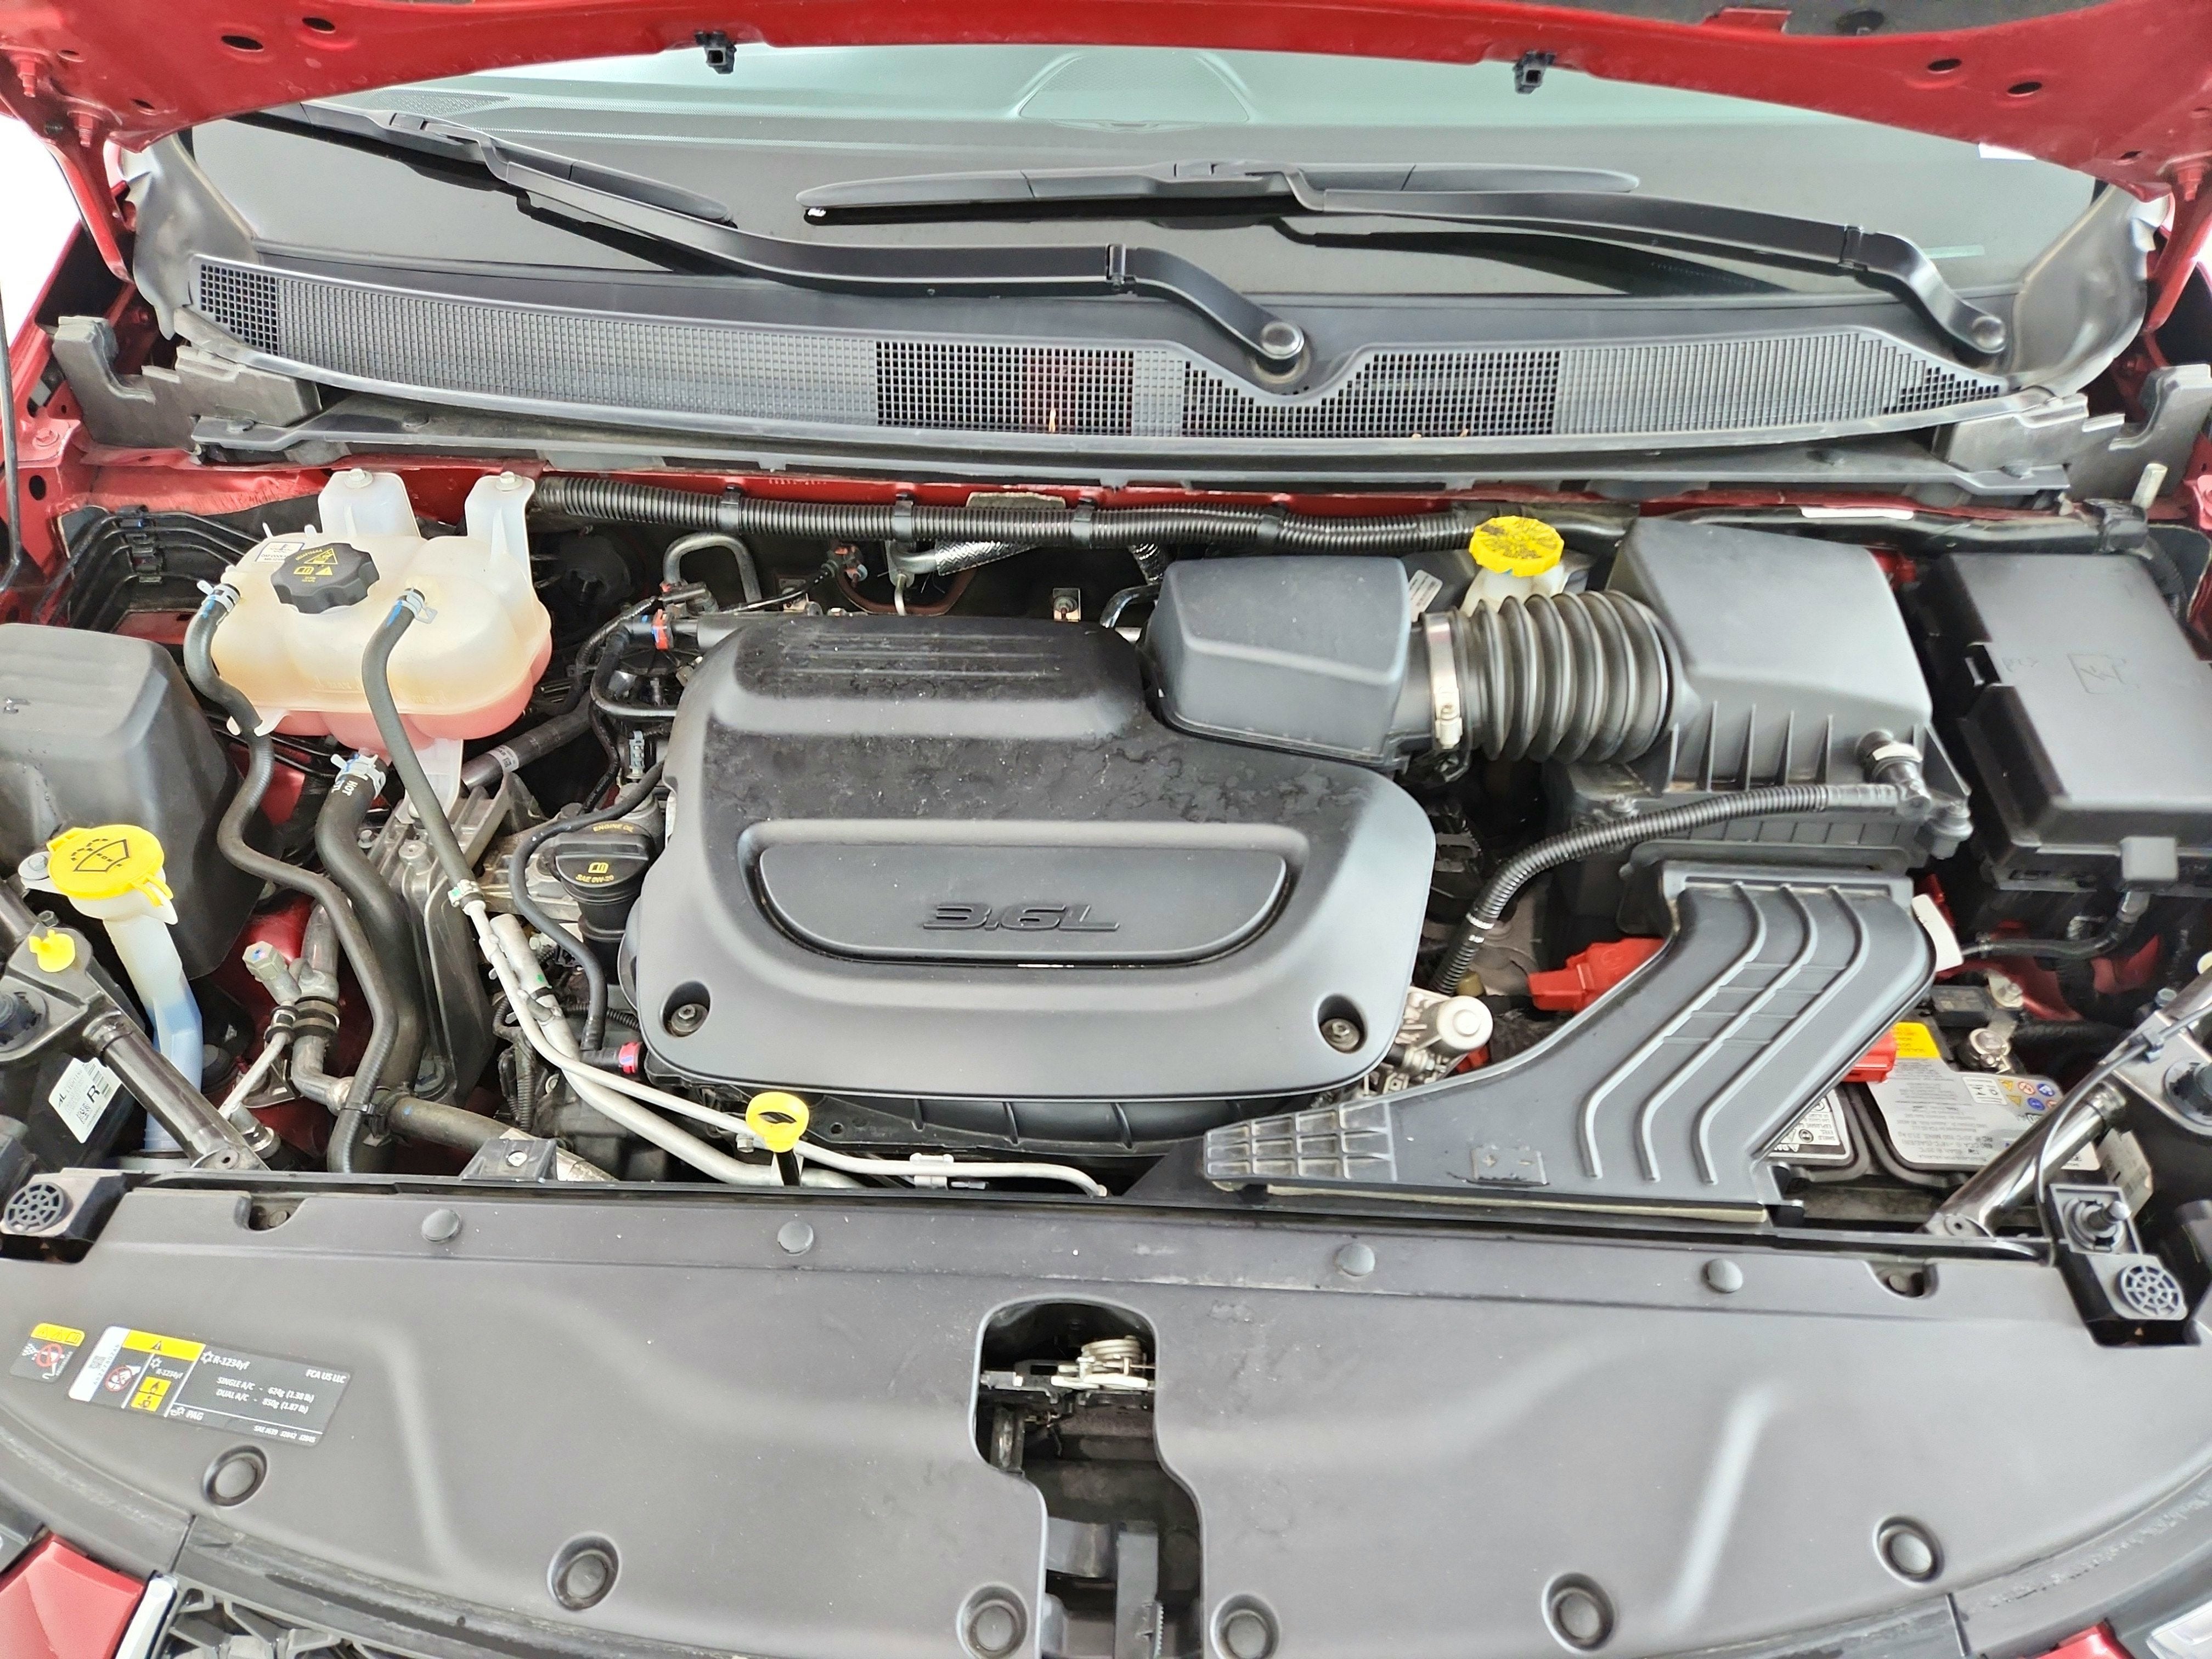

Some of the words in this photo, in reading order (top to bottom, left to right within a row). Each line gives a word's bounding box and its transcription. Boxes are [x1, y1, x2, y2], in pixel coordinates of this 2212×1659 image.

[342, 780, 358, 796] HOT
[592, 823, 623, 832] ENGINE
[623, 824, 635, 833] OIL
[575, 874, 592, 883] SAE
[923, 904, 1120, 932] 3.6L
[87, 1085, 100, 1104] R
[212, 1355, 250, 1370] R-1234yf
[306, 1369, 320, 1379] FCA
[321, 1372, 334, 1381] US
[332, 1374, 347, 1383] LLC
[216, 1377, 241, 1388] SINGLE
[240, 1381, 255, 1390] A/C
[268, 1387, 285, 1398] 624g
[303, 1393, 314, 1403] lb)
[216, 1389, 236, 1399] DUAL
[235, 1392, 249, 1401] A/C
[280, 1402, 299, 1412] (1.87
[297, 1404, 309, 1414] lb)
[185, 1410, 204, 1421] PAG
